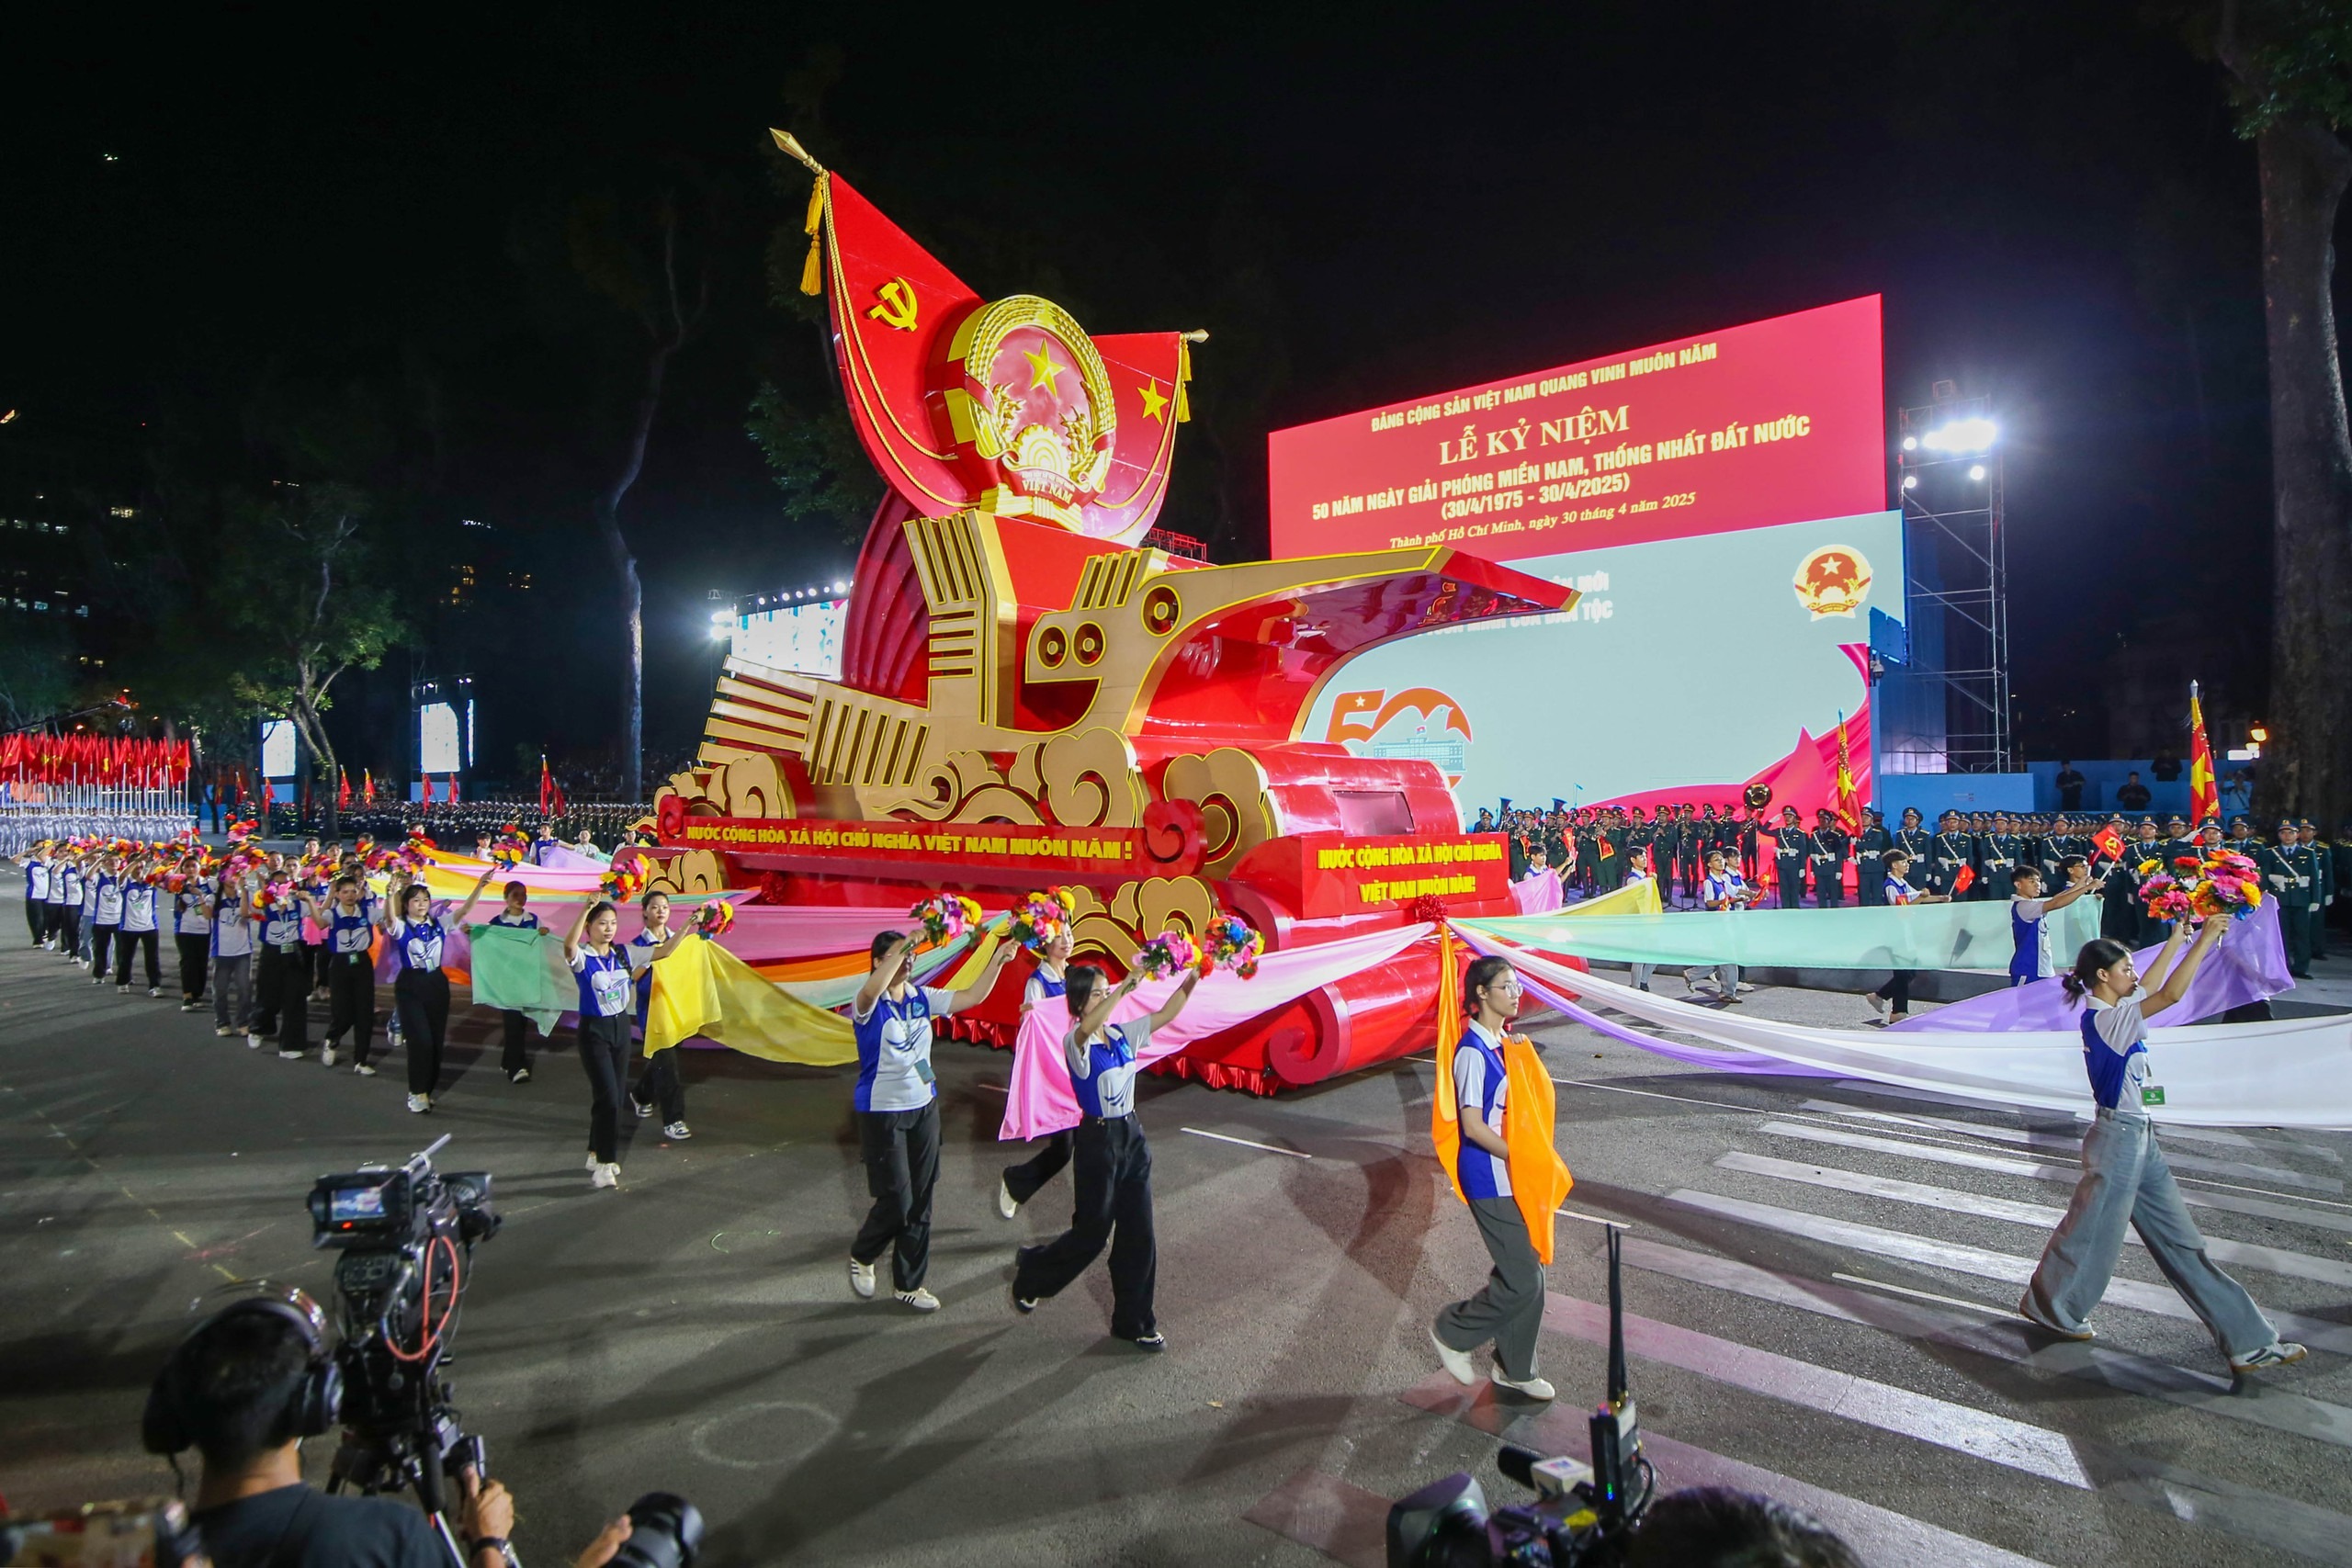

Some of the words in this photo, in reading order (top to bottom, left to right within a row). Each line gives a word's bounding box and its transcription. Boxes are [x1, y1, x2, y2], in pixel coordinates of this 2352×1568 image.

[1371, 412, 1404, 432] ĐẢNG
[1407, 406, 1441, 425] CỘNG
[1443, 395, 1470, 416] SẢN
[1474, 389, 1501, 411] VIỆT
[1504, 382, 1536, 403] NAM
[1540, 372, 1588, 397] QUANG
[1590, 363, 1626, 384] VINH
[1629, 352, 1676, 377] MUÔN
[1679, 343, 1717, 366] NĂM
[1439, 424, 1478, 465] LỄ
[1486, 417, 1532, 457] KỶ
[1540, 405, 1630, 446] NIỆM
[1312, 502, 1329, 520] 50
[1332, 495, 1363, 517] NĂM
[1367, 488, 1404, 511] NGÀY
[1408, 478, 1438, 503] GIẢI
[1442, 474, 1494, 498] PHÓNG
[1544, 457, 1589, 476] NAM,
[1593, 442, 1652, 472] THỐNG
[1657, 429, 1706, 461] NHẤT
[1711, 421, 1748, 452] ĐẤT
[1754, 413, 1810, 445] NƯỚC
[1022, 479, 1046, 494] VIỆT
[1049, 484, 1073, 504] NAM
[1442, 490, 1523, 520] (30/4/1975
[1539, 472, 1630, 503] 30/4/2025)
[1390, 535, 1422, 549] Thành
[1424, 528, 1447, 547] phố
[1448, 526, 1464, 541] Hồ
[1467, 524, 1489, 537] Chí
[1490, 520, 1525, 535] Minh,
[1528, 514, 1558, 531] ngày
[1561, 511, 1577, 524] 30
[1580, 507, 1615, 522] tháng
[1618, 502, 1627, 515] 4
[1630, 500, 1658, 514] năm
[1661, 492, 1696, 509] 2025
[1582, 598, 1613, 624] TỘC
[687, 823, 721, 840] NƯỚC
[722, 825, 756, 843] CỘNG
[758, 826, 786, 843] HÒA
[789, 829, 810, 845] XÃ
[812, 829, 839, 849] HỘI
[841, 829, 871, 847] CHỦ
[873, 830, 922, 850] NGHĨA
[923, 832, 962, 854] VIỆT
[965, 836, 1007, 854] NAM
[1010, 836, 1068, 857] MUÔN
[1317, 843, 1354, 869] NƯỚC
[1355, 845, 1389, 870] CỘNG
[1389, 843, 1415, 865] HÒA
[1416, 843, 1433, 863] XÃ
[1433, 841, 1453, 865] HỘI
[1453, 840, 1473, 862] CHỦ
[1474, 840, 1503, 862] NGHĨA
[1360, 879, 1389, 906] VIỆT
[1389, 880, 1417, 900] NAM
[1417, 874, 1448, 897] MUÔN
